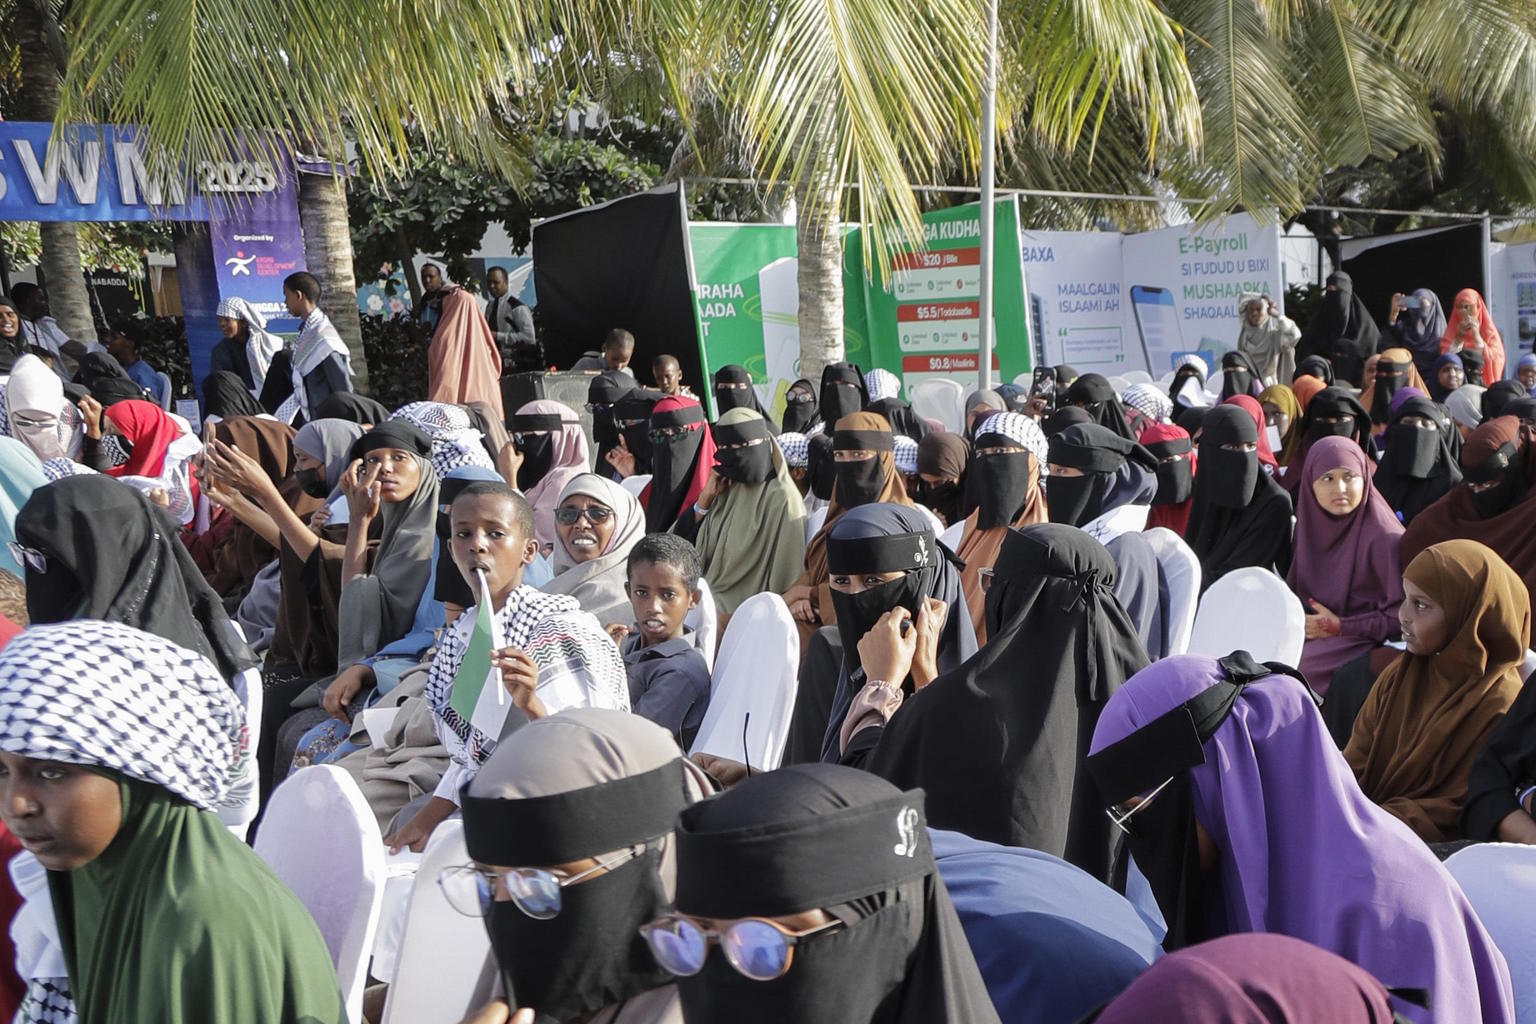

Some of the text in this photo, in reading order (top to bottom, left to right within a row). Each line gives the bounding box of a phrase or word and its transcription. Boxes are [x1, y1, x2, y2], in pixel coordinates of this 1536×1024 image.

[0, 138, 277, 204] WM 2025
[1178, 231, 1248, 256] E-Payroll
[923, 253, 941, 266] $20
[1182, 258, 1270, 276] SI FUDUD U BIXI
